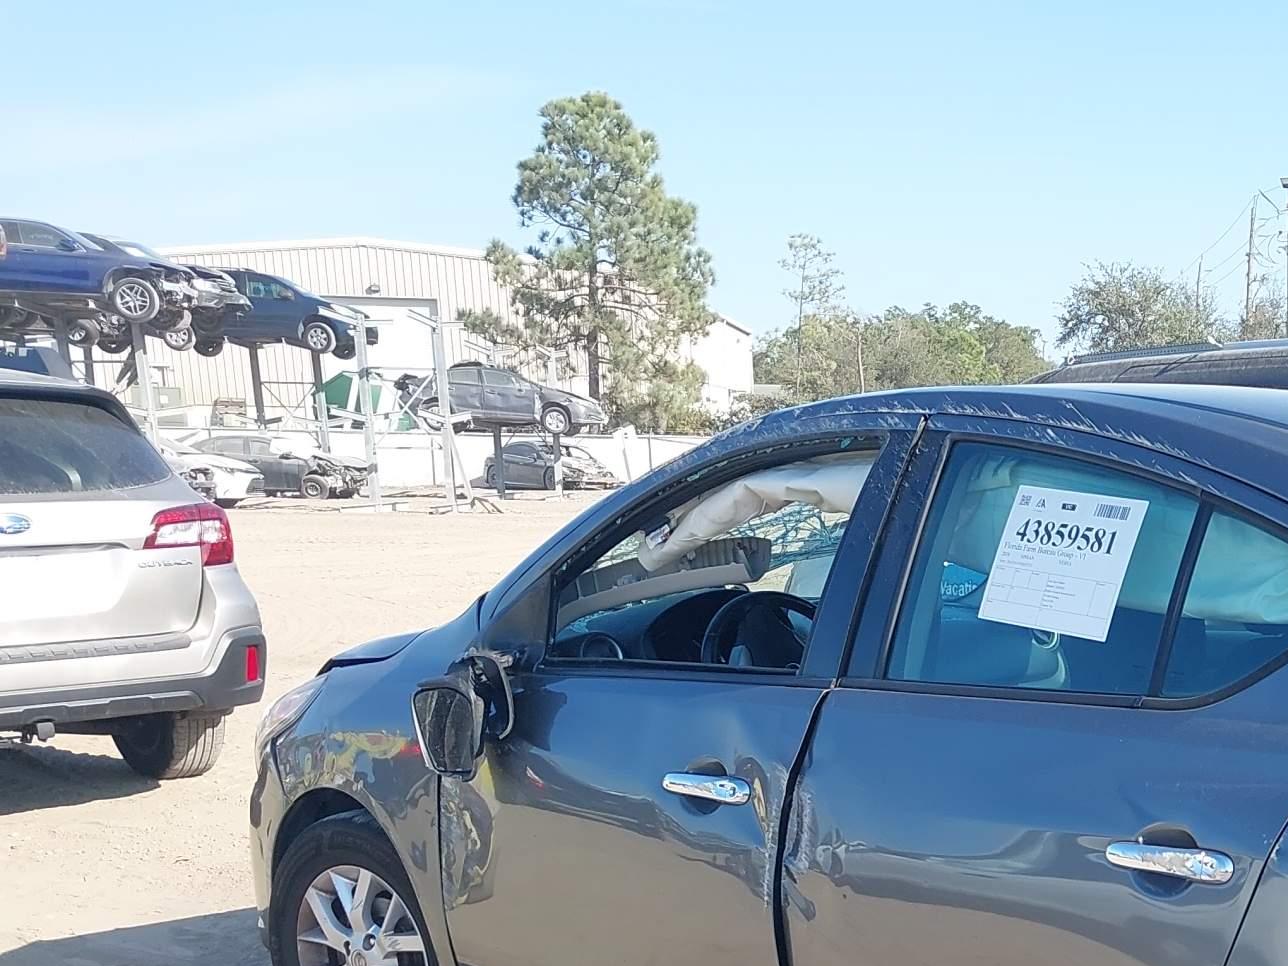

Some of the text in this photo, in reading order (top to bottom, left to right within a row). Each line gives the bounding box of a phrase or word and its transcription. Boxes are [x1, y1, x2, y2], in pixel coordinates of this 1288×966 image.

[1016, 518, 1118, 555] 43859581
[1022, 544, 1036, 552] Farm
[1055, 549, 1074, 560] Group
